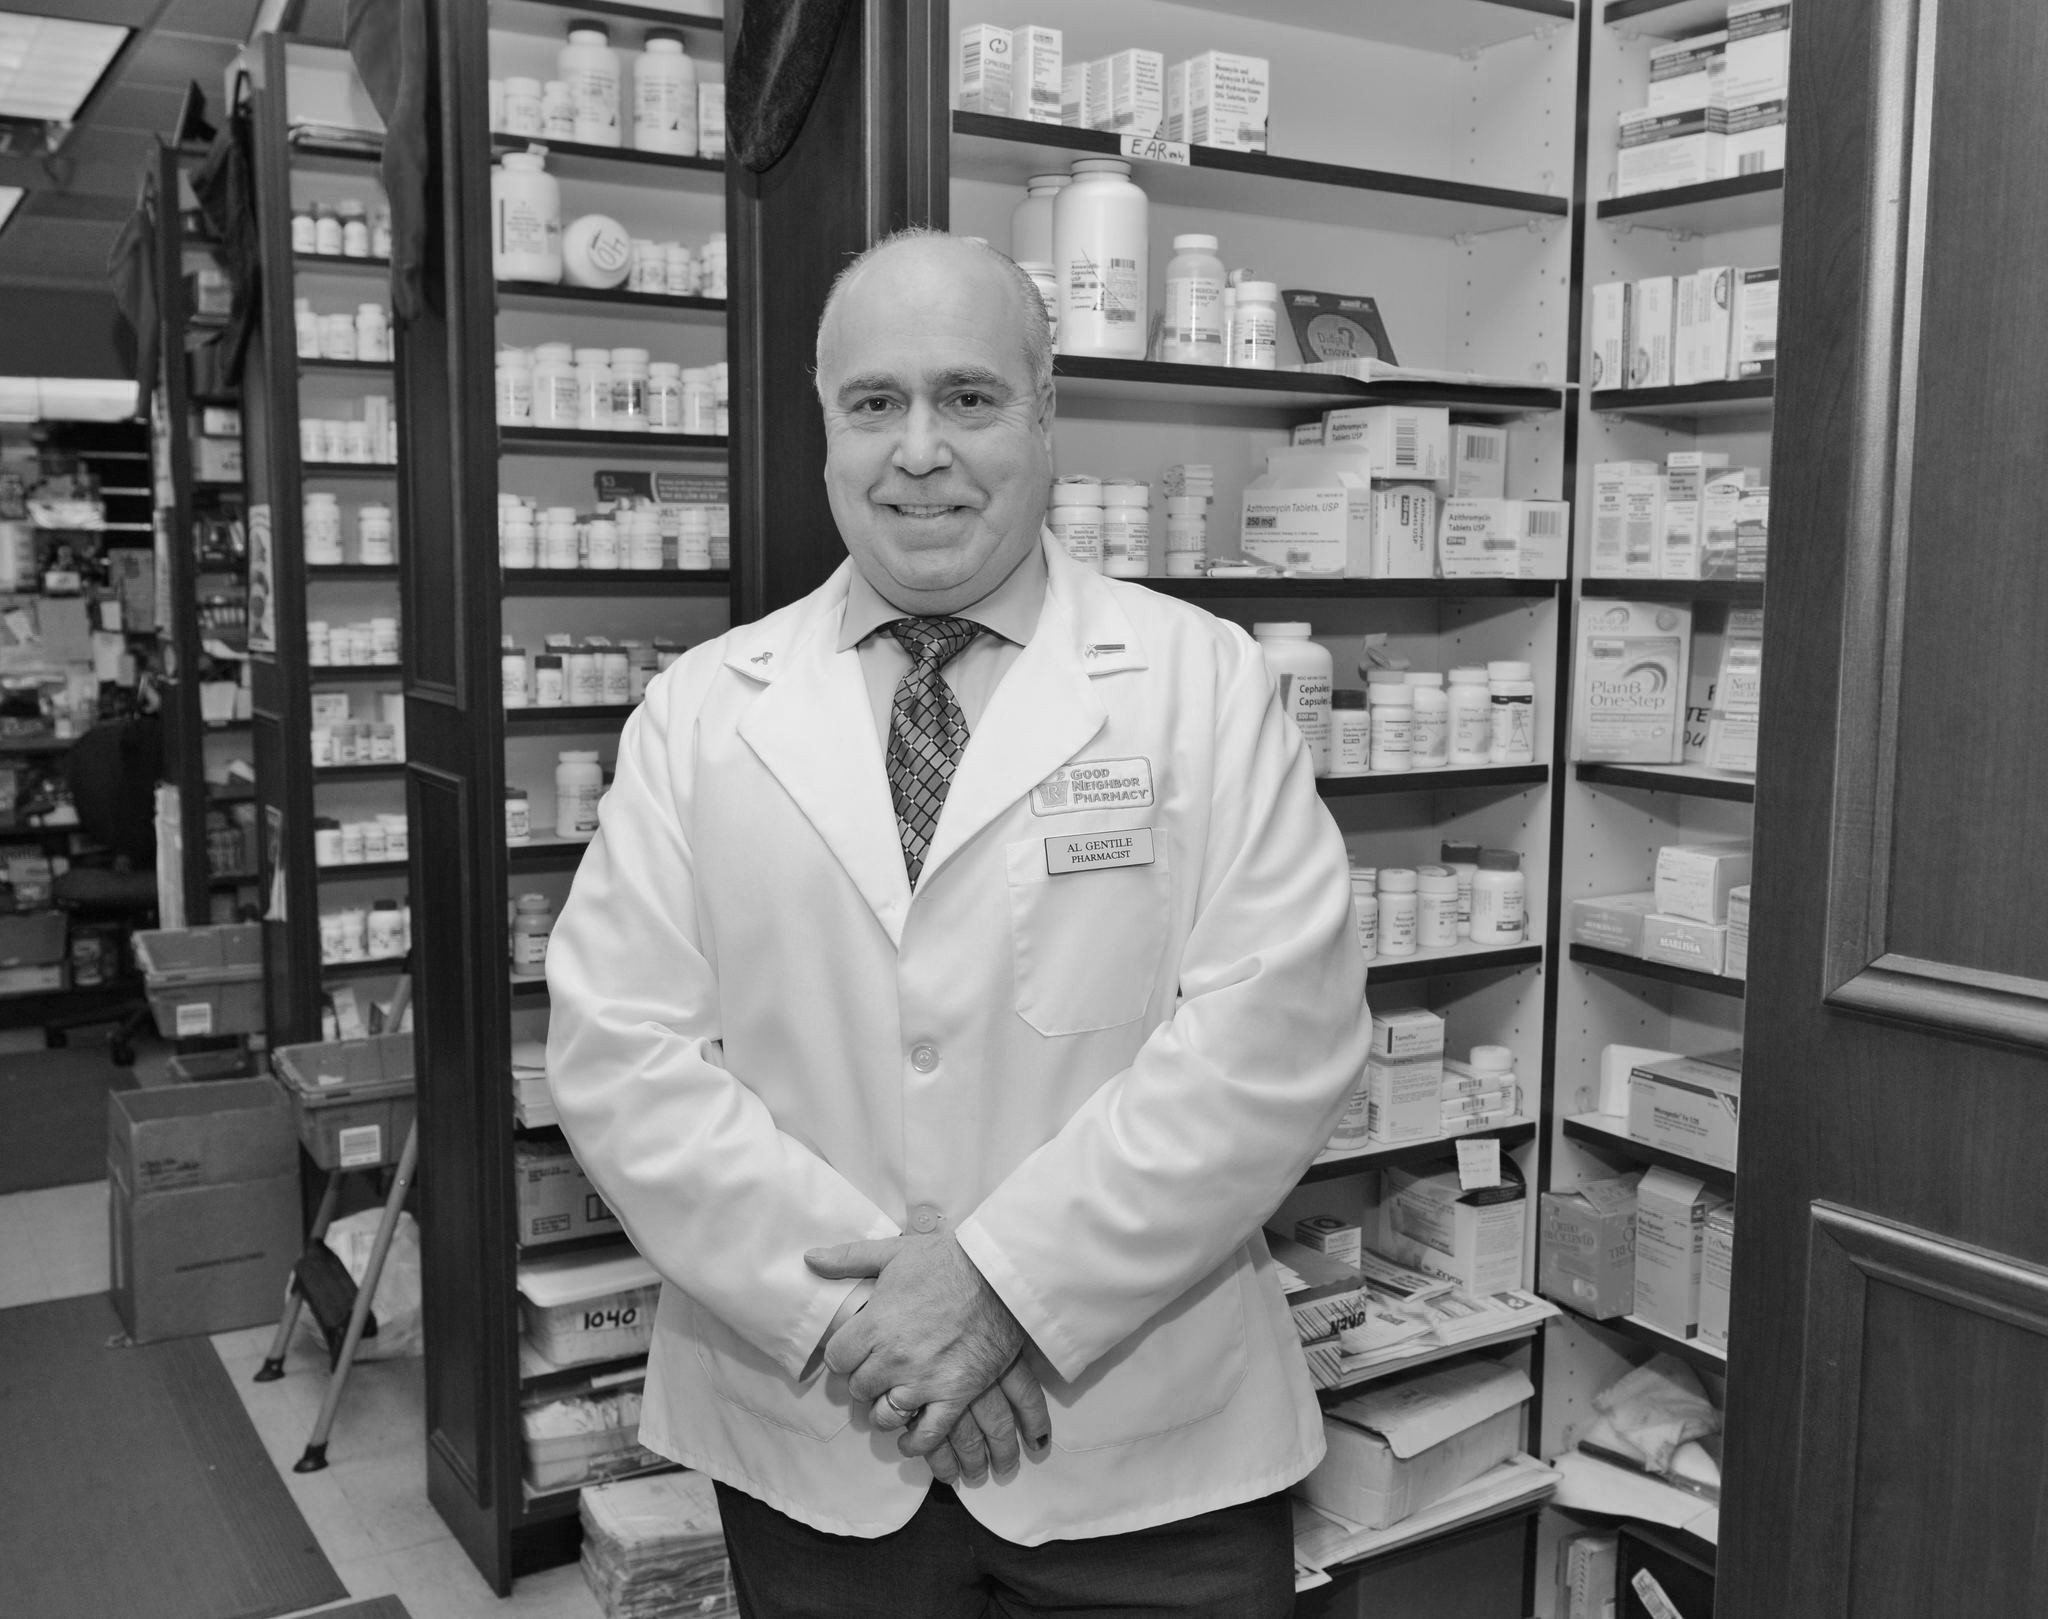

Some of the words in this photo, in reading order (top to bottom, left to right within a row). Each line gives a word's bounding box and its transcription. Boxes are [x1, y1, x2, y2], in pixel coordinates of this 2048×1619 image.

[1131, 139, 1168, 160] EAR
[1246, 504, 1290, 514] Azithromycin
[1322, 502, 1340, 512] USP
[1449, 513, 1491, 522] Azithromycin
[1449, 523, 1472, 532] Tablets
[1590, 695, 1665, 710] One-Step
[1070, 768, 1110, 780] GOOD
[1071, 777, 1140, 792] NEIGHBOR
[1073, 789, 1149, 804] PHARMACY
[1067, 843, 1082, 852] AL
[1085, 838, 1133, 851] GENTILE
[1071, 850, 1131, 863] PHARMACIST
[584, 1307, 637, 1330] 1040
